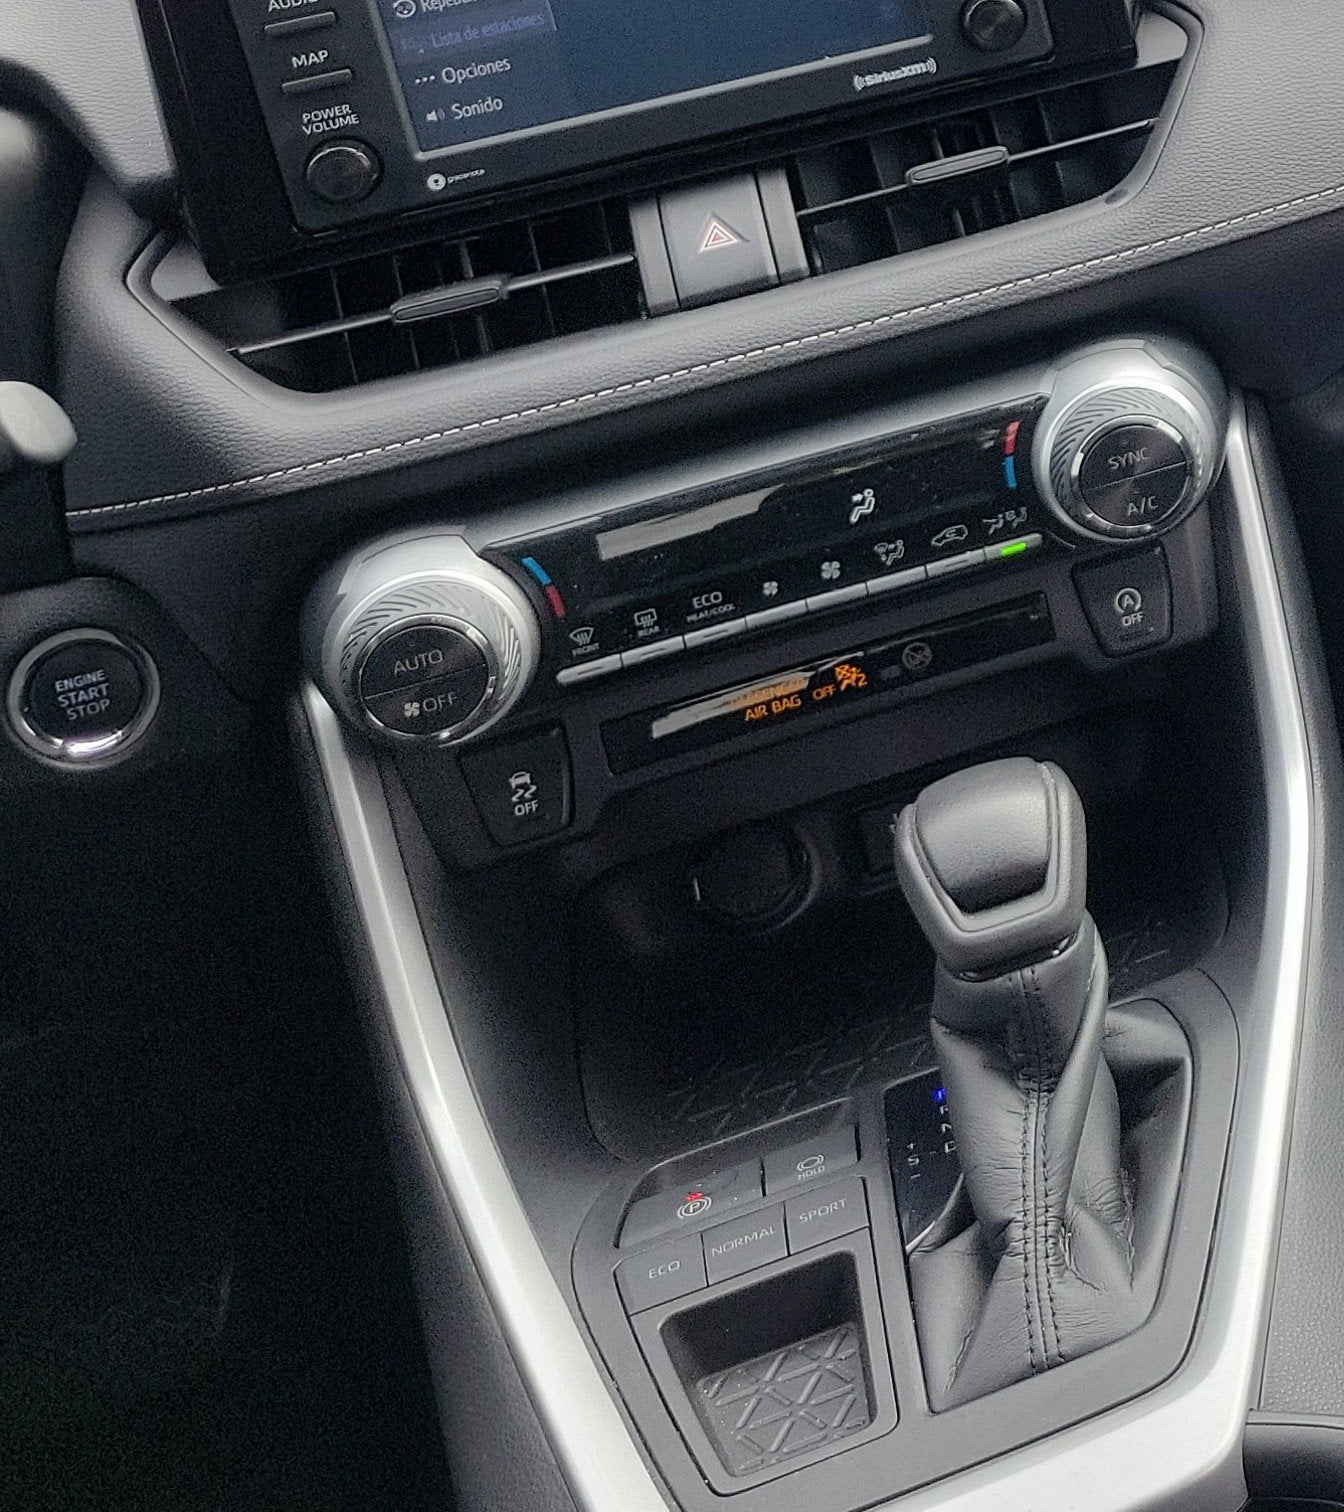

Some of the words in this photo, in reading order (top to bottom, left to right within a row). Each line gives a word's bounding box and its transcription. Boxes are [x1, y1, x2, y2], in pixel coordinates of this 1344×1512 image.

[291, 49, 329, 69] MAP
[441, 58, 511, 85] Opciones
[302, 104, 352, 124] POWER
[451, 96, 503, 120] Sonido
[302, 113, 360, 136] VOLUME
[1108, 446, 1150, 470] SYNC
[1126, 495, 1158, 516] A/C
[692, 591, 723, 609] ECO
[1122, 611, 1145, 627] OFF
[394, 649, 443, 676] AUTO
[54, 668, 105, 693] ENGINE
[57, 682, 110, 708] START
[422, 691, 458, 713] OFF
[744, 704, 769, 722] AIR
[771, 694, 802, 714] BAG
[812, 683, 836, 701] OFF
[66, 697, 111, 722] STOP
[514, 799, 539, 816] OFF
[798, 1166, 825, 1181] HOLD
[800, 1197, 849, 1223] SPORT
[711, 1226, 776, 1257] NORMAL
[649, 1260, 680, 1279] ECO
